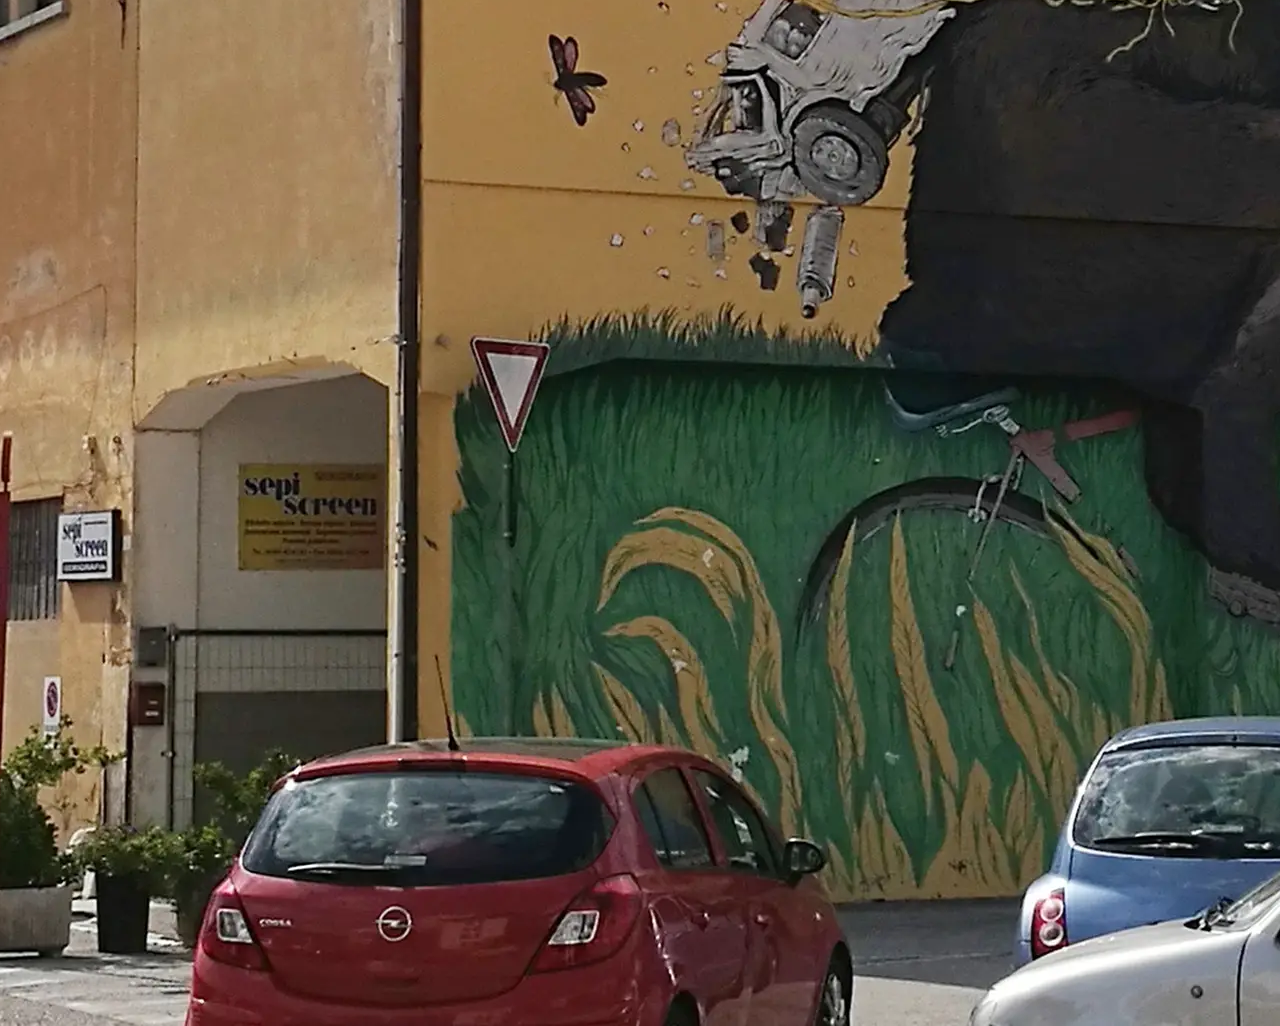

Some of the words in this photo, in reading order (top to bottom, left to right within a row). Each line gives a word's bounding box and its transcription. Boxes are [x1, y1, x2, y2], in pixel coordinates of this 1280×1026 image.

[244, 472, 300, 501] sepi
[284, 497, 377, 515] screen
[62, 516, 81, 544] sepi
[75, 540, 108, 558] screen
